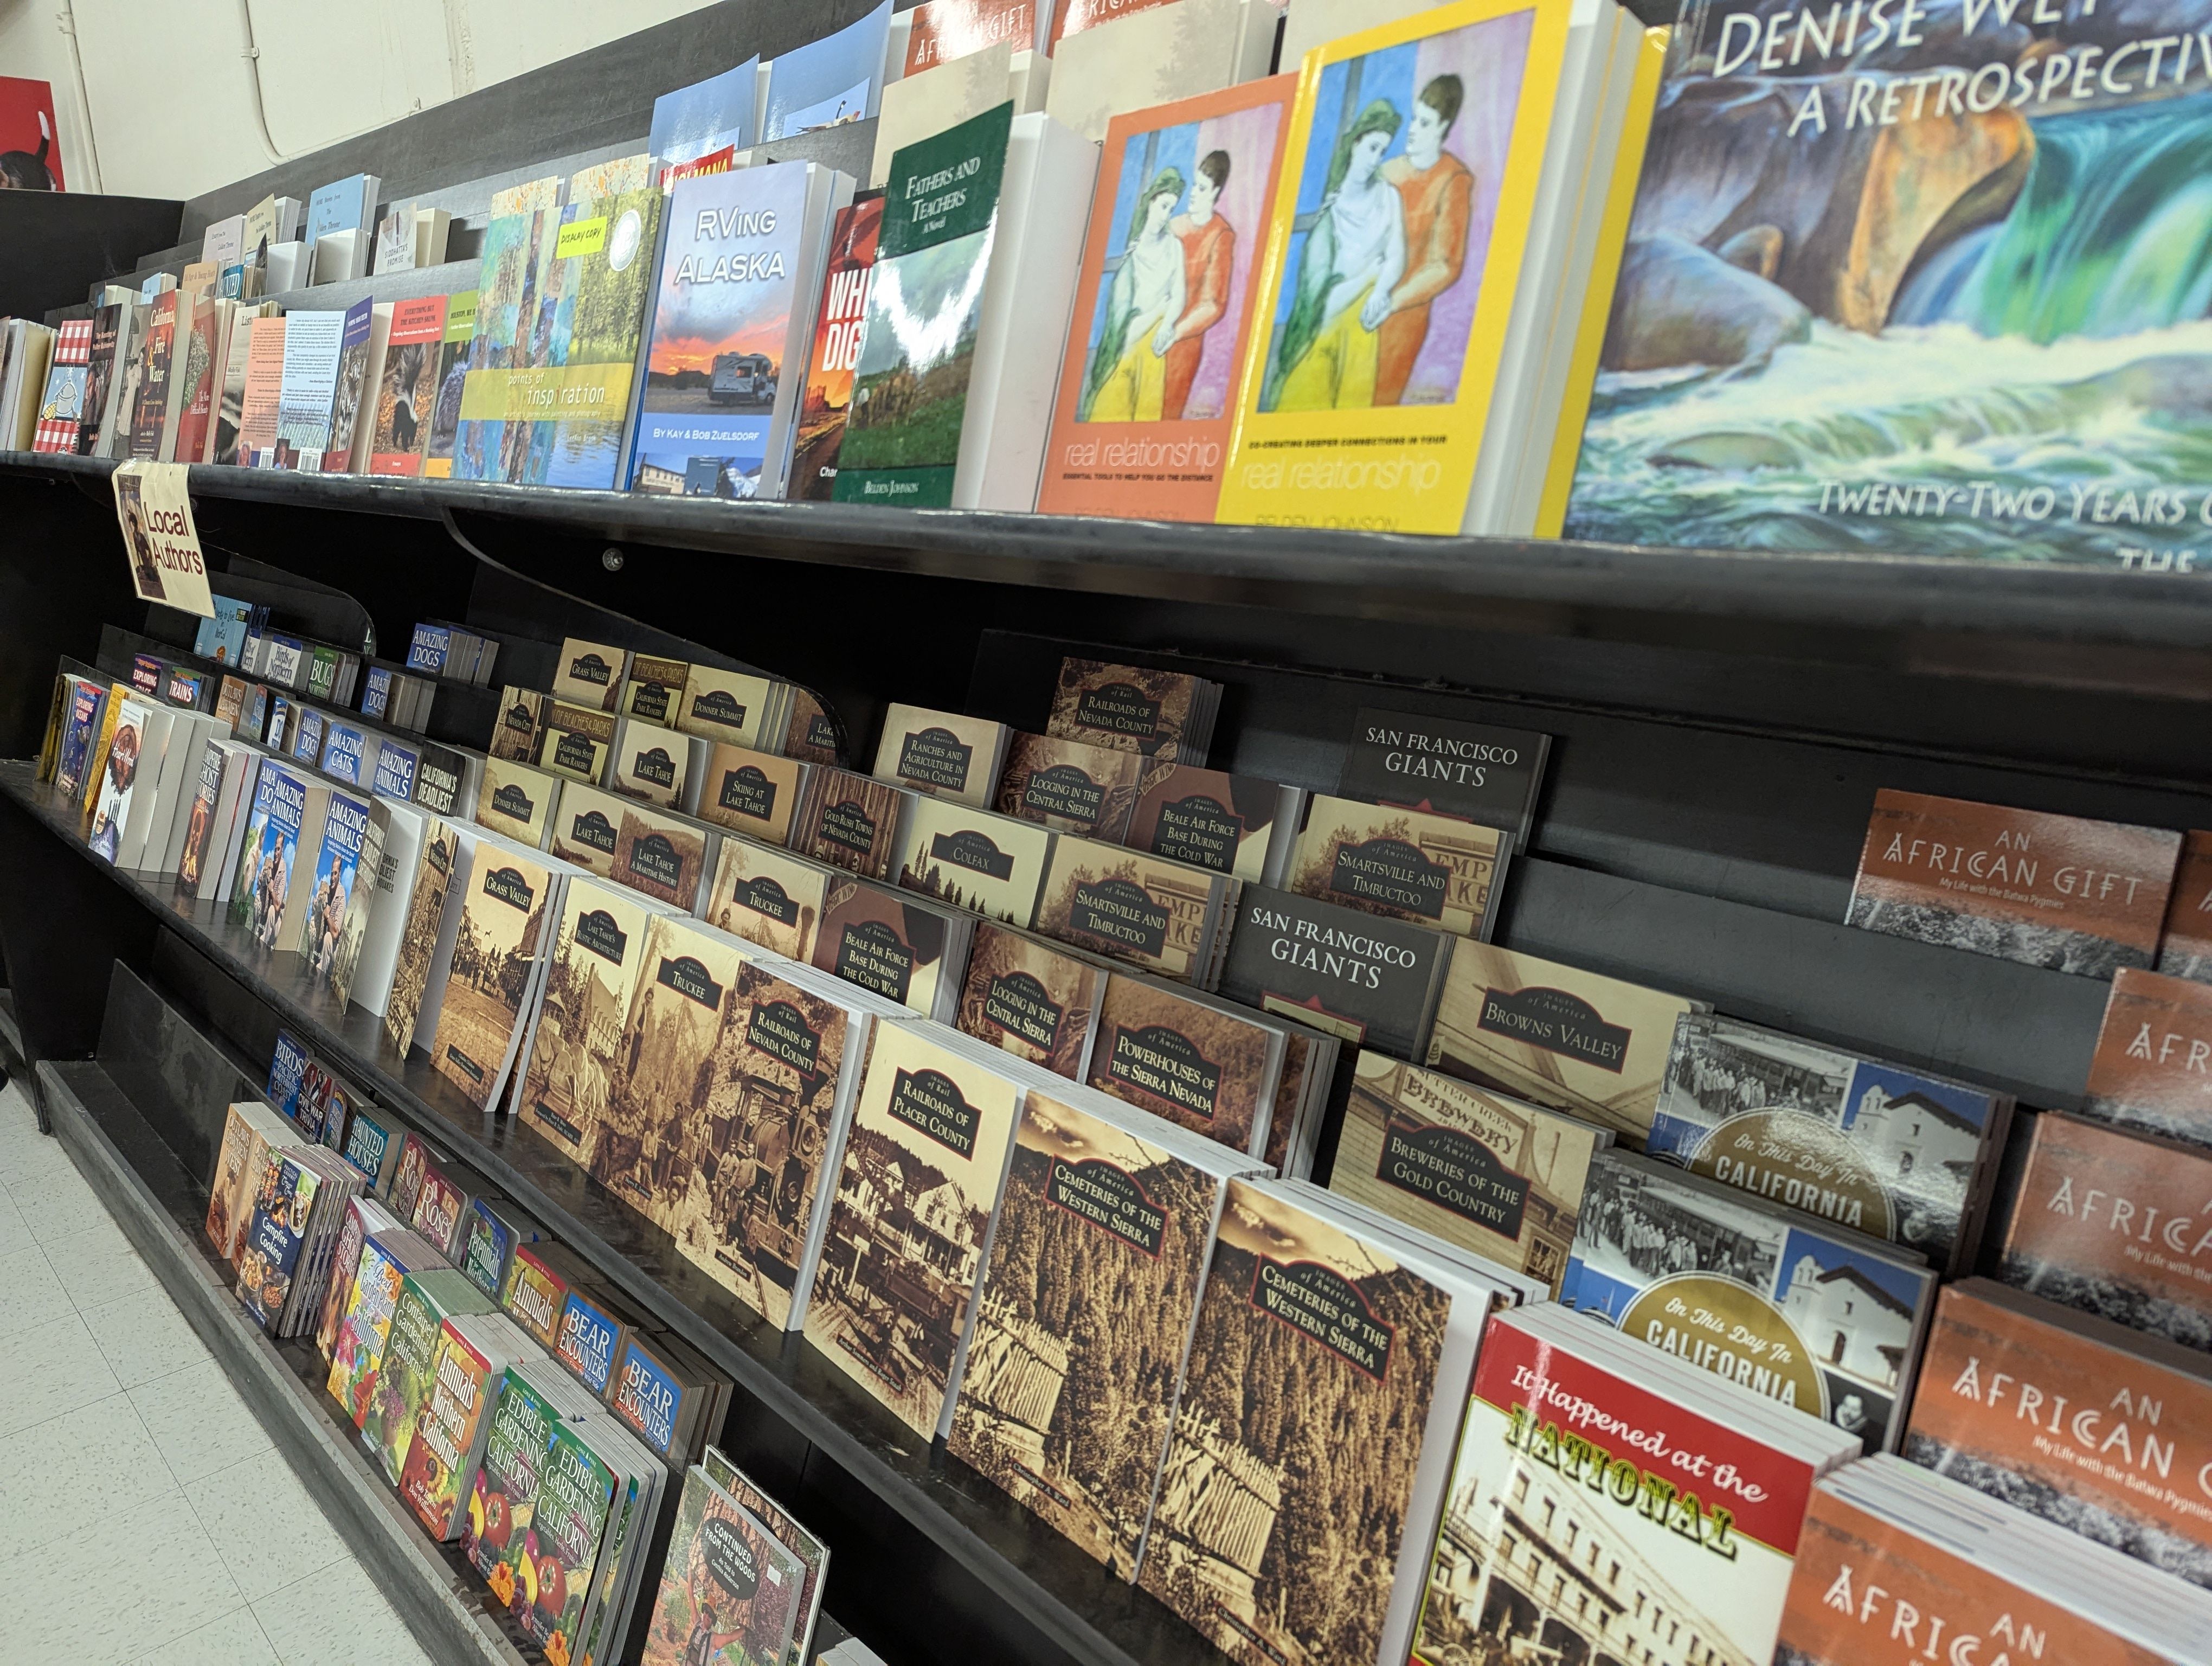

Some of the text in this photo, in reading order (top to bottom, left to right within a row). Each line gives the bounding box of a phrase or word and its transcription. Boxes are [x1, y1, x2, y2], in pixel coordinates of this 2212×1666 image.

[989, 4, 1025, 41] GIFT
[1713, 0, 1926, 78] DENISE
[1787, 85, 1827, 138] A
[905, 157, 981, 199] FATHERS AND
[912, 188, 966, 222] TEACHERS
[384, 244, 408, 259] SIDDHATTA'S
[561, 226, 601, 244] DISPLAY COPY
[388, 255, 403, 267] PROMISE
[674, 252, 785, 285] ALASKA
[151, 305, 175, 326] California
[404, 306, 426, 316] EVERYTHING
[147, 347, 155, 366] &
[155, 336, 165, 354] Fire
[149, 366, 164, 382] Water
[509, 373, 544, 386] points of
[528, 383, 605, 409] inspiration
[653, 428, 759, 441] BY KAY & BOB ZUELSDORF
[1305, 438, 1338, 447] DEEPER
[1064, 436, 1219, 473] real relationship
[864, 480, 919, 497] BELDEN JOHNSON
[1241, 452, 1441, 496] real relationship
[144, 502, 189, 536] Local
[1818, 480, 2055, 521] TWENTY-TWO
[2069, 483, 2187, 525] YEARS
[152, 538, 202, 575] Authors
[413, 630, 448, 651] AMAZING
[413, 647, 440, 667] DOGS
[133, 669, 157, 687] EXPLORING
[310, 659, 335, 687] BUGS
[572, 664, 609, 681] GRASS VALLEY
[76, 697, 94, 712] EXPLORING
[169, 681, 192, 702] TRAINS
[76, 709, 88, 722] OCEANS
[695, 701, 742, 722] DONNER SUMMIT
[329, 731, 362, 758] AMAZING
[911, 740, 962, 760] RANCHES AND
[1366, 727, 1518, 765] SAN FRANCISCO
[331, 751, 354, 773] CATS
[421, 763, 457, 793] CALIFORNIA'S
[901, 763, 962, 787] NEVADA COUNTY
[904, 751, 963, 774] AGRICULTURE IN
[1385, 752, 1487, 787] GIANTS
[418, 782, 453, 811] DEADLIEST
[726, 792, 765, 814] LAKE TAHOE
[733, 780, 764, 799] SKIING AT
[329, 800, 366, 834] AMAZING
[825, 809, 873, 835] GOLD RUSH TOWNS
[326, 821, 362, 853] ANIMALS
[821, 823, 871, 849] OF NEVADA COUNTY
[1995, 830, 2030, 851] AN
[953, 847, 990, 870] COLFAX
[1883, 832, 2143, 905] AFRICAN GIFT
[750, 893, 782, 917] TRUCKEE
[1486, 1003, 1621, 1059] BROWNS VALLEY
[276, 1039, 305, 1077] BIRDS
[1118, 1035, 1216, 1090] POWERHOUSES OF
[904, 1080, 969, 1126] RAILROADS OF
[1111, 1060, 1212, 1112] THE SIERRA NEVADA
[353, 1115, 384, 1156] HAUNTED
[894, 1097, 970, 1150] PLACER COUNTY
[348, 1137, 379, 1176] HOUSES
[1391, 1137, 1518, 1205] BREWERIES OF THE
[1394, 1162, 1506, 1224] GOLD COUNTRY
[419, 1182, 452, 1244] Roses
[260, 1233, 282, 1264] Cooking
[262, 1217, 288, 1247] Campfire
[403, 1293, 433, 1339] Container
[1262, 1265, 1388, 1351] CEMETERIES OF THE
[396, 1310, 432, 1361] Gardening
[568, 1307, 610, 1359] BEAR
[1265, 1288, 1374, 1369] WESTERN SIERRA
[1666, 1297, 1792, 1364] On This Day In
[560, 1333, 607, 1382] ENCOUNTERS
[1647, 1318, 1798, 1409] CALIFORNIA
[437, 1347, 476, 1409] Annuals
[432, 1383, 465, 1441] Northern
[422, 1412, 460, 1472] California
[1511, 1365, 1768, 1502] It Happened at the
[560, 1448, 601, 1505] EDIBLE
[1505, 1402, 1737, 1561] NATIONAL
[545, 1465, 601, 1537] GARDENING
[538, 1495, 593, 1570] CALIFORNIA
[714, 1523, 751, 1564] CONTINUED
[705, 1529, 756, 1582] FROM THE WOODS
